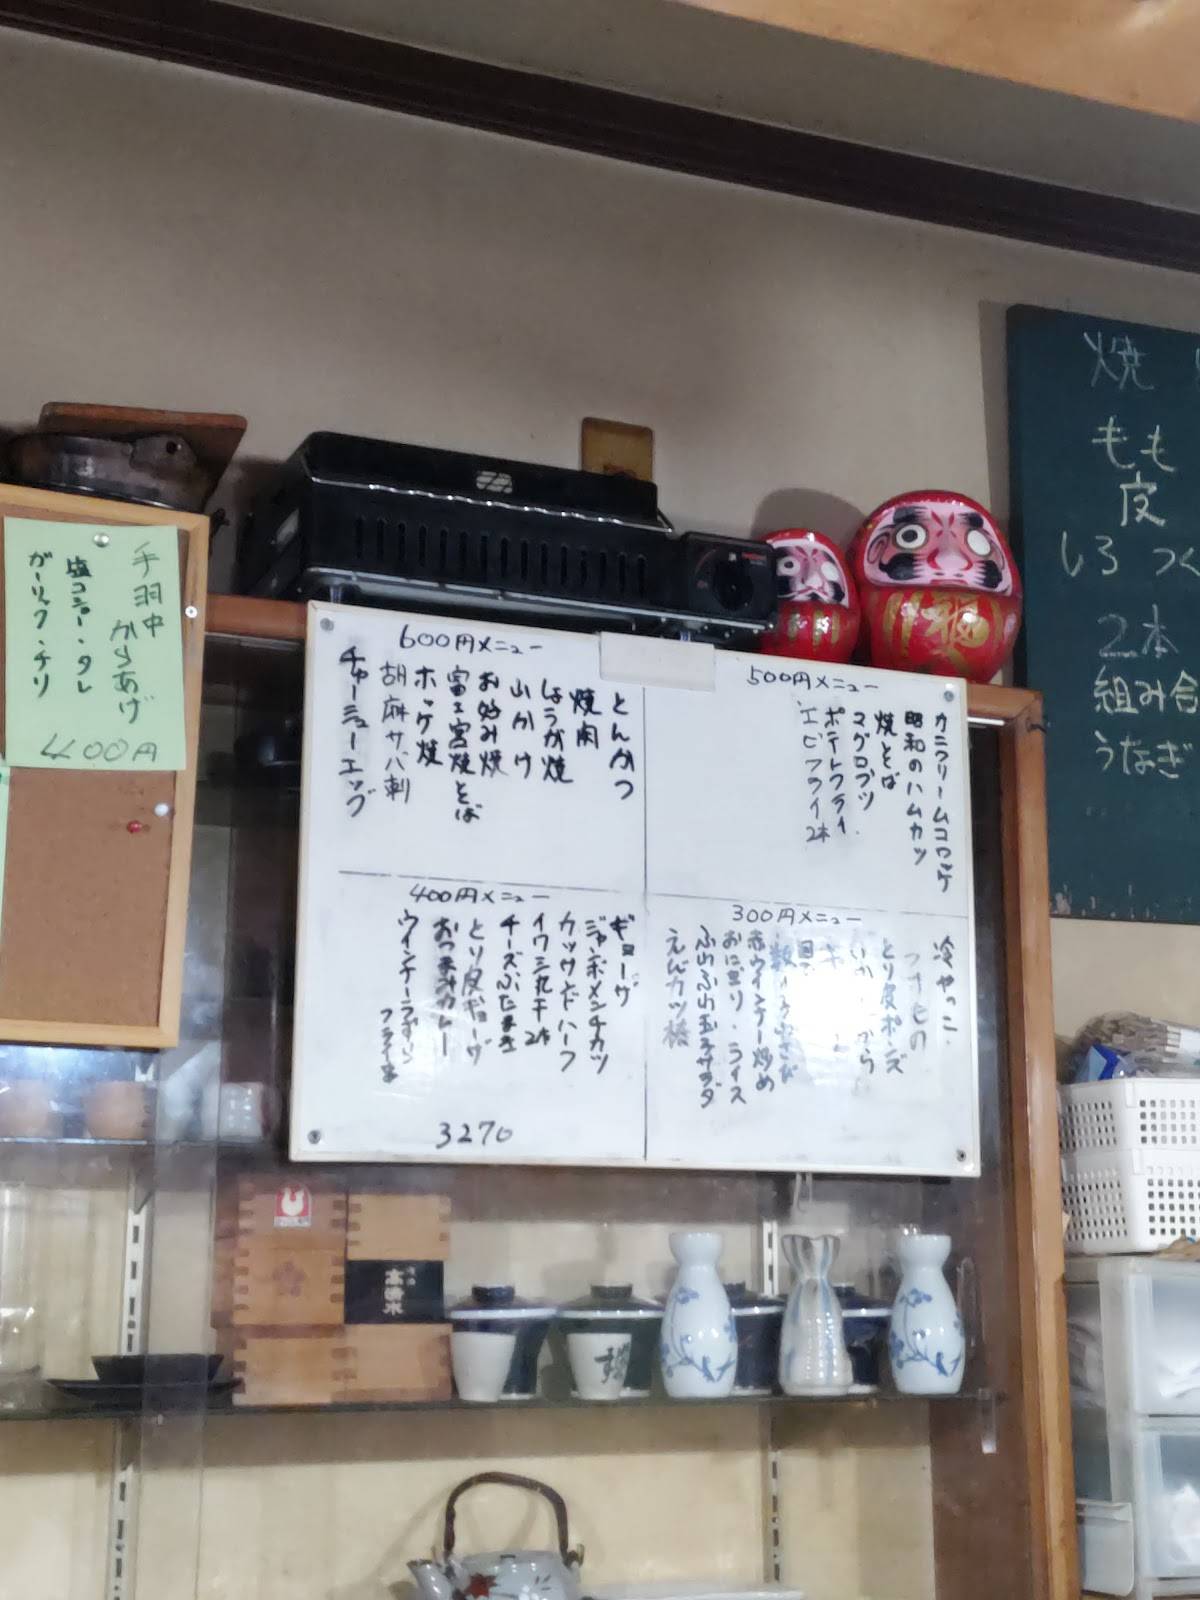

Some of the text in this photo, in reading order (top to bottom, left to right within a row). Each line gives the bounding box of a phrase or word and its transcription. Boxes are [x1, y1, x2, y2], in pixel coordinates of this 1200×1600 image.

[1091, 416, 1175, 473] もも
[1119, 470, 1165, 528] 皮
[132, 541, 164, 638] 手羽中
[1060, 531, 1119, 577] しろ
[110, 620, 154, 723] からあげ
[399, 624, 544, 656] 600円メニュー
[747, 665, 880, 693] 500円メニュー
[1097, 603, 1179, 658] 2本
[40, 733, 158, 763] 400円
[339, 646, 376, 818] チャーシューエッグ
[380, 661, 410, 804] 胡麻サバ刺
[414, 666, 443, 766] ホッケ焼
[446, 665, 483, 823] 富士宮焼そば
[477, 672, 511, 778] お好み焼
[510, 679, 535, 780] 山かけ
[541, 678, 574, 783] しょうが焼
[570, 688, 602, 749] 焼肉
[610, 696, 634, 800] とんかつ
[852, 711, 874, 812] マグロブツ
[875, 711, 899, 790] 焼そば
[1094, 730, 1193, 779] うなぎ
[824, 706, 847, 835] ポテトフライ
[903, 711, 927, 866] 昭和のハムカツ
[410, 884, 551, 904] 400円メニュー
[732, 904, 864, 926] 300円メニュー
[461, 918, 492, 1066] とり皮ギョーザ
[585, 915, 608, 1074] ジャンボメンチカツ
[610, 914, 639, 1007] ギョーザ
[881, 937, 907, 1075] とり皮ポンズ
[933, 935, 958, 1032] 冷やっこ
[436, 1121, 513, 1149] 3270
